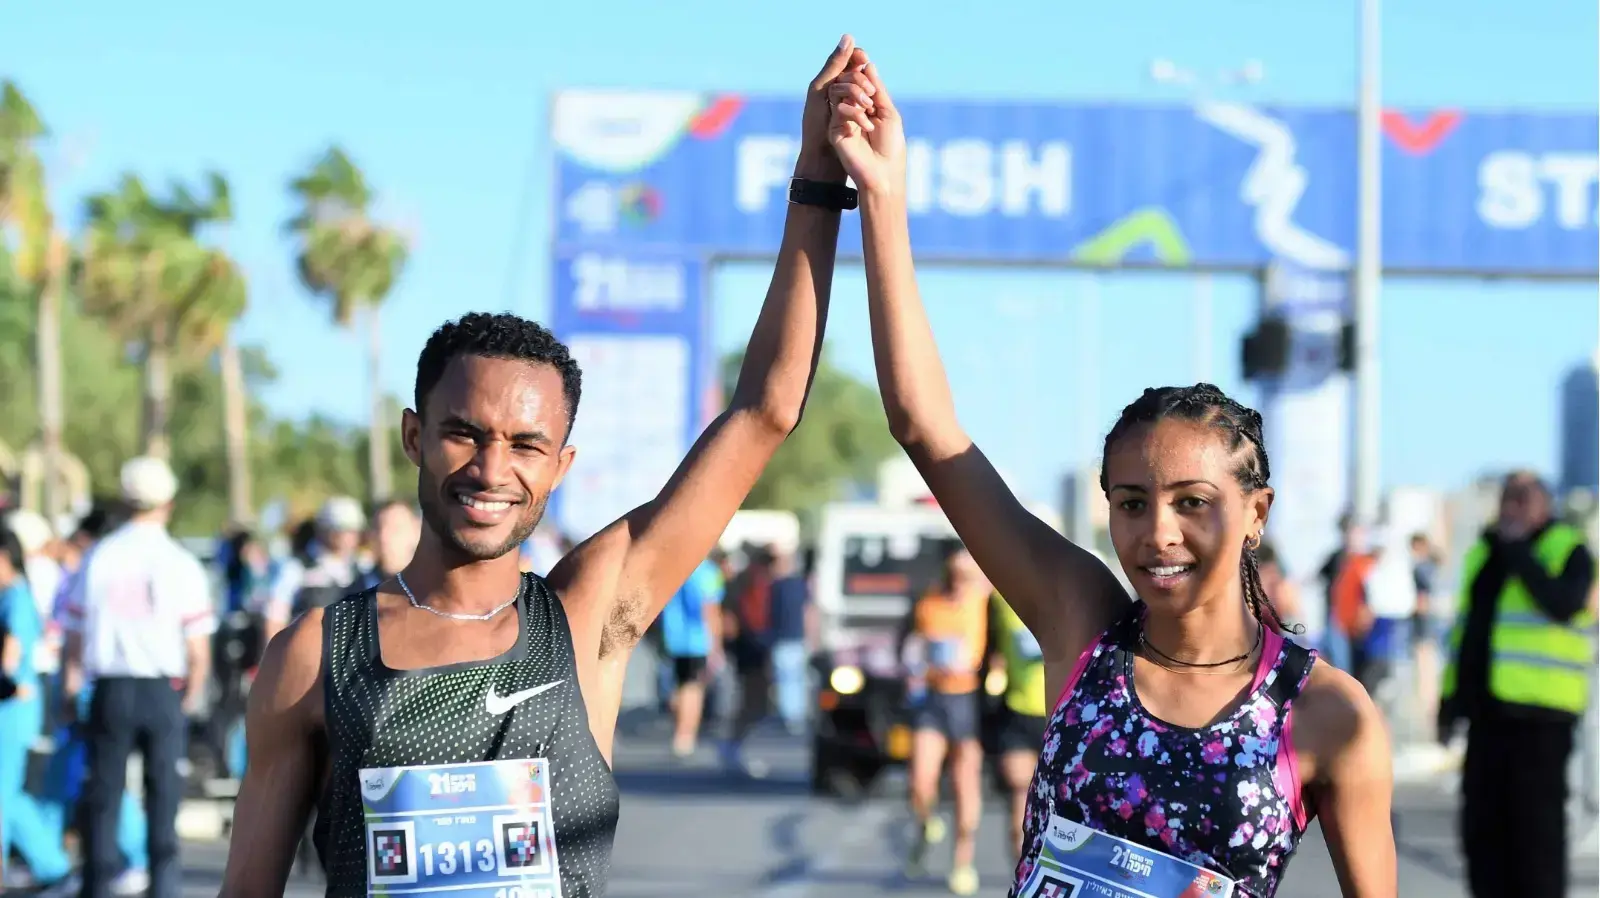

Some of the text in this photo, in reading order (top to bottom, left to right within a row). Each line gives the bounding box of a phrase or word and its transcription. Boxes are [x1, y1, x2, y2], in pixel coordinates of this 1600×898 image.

[735, 137, 1072, 215] FISH
[1475, 150, 1599, 229] ST
[420, 839, 495, 876] 1313
[1110, 845, 1131, 868] 21
[1126, 859, 1152, 877] חיפה
